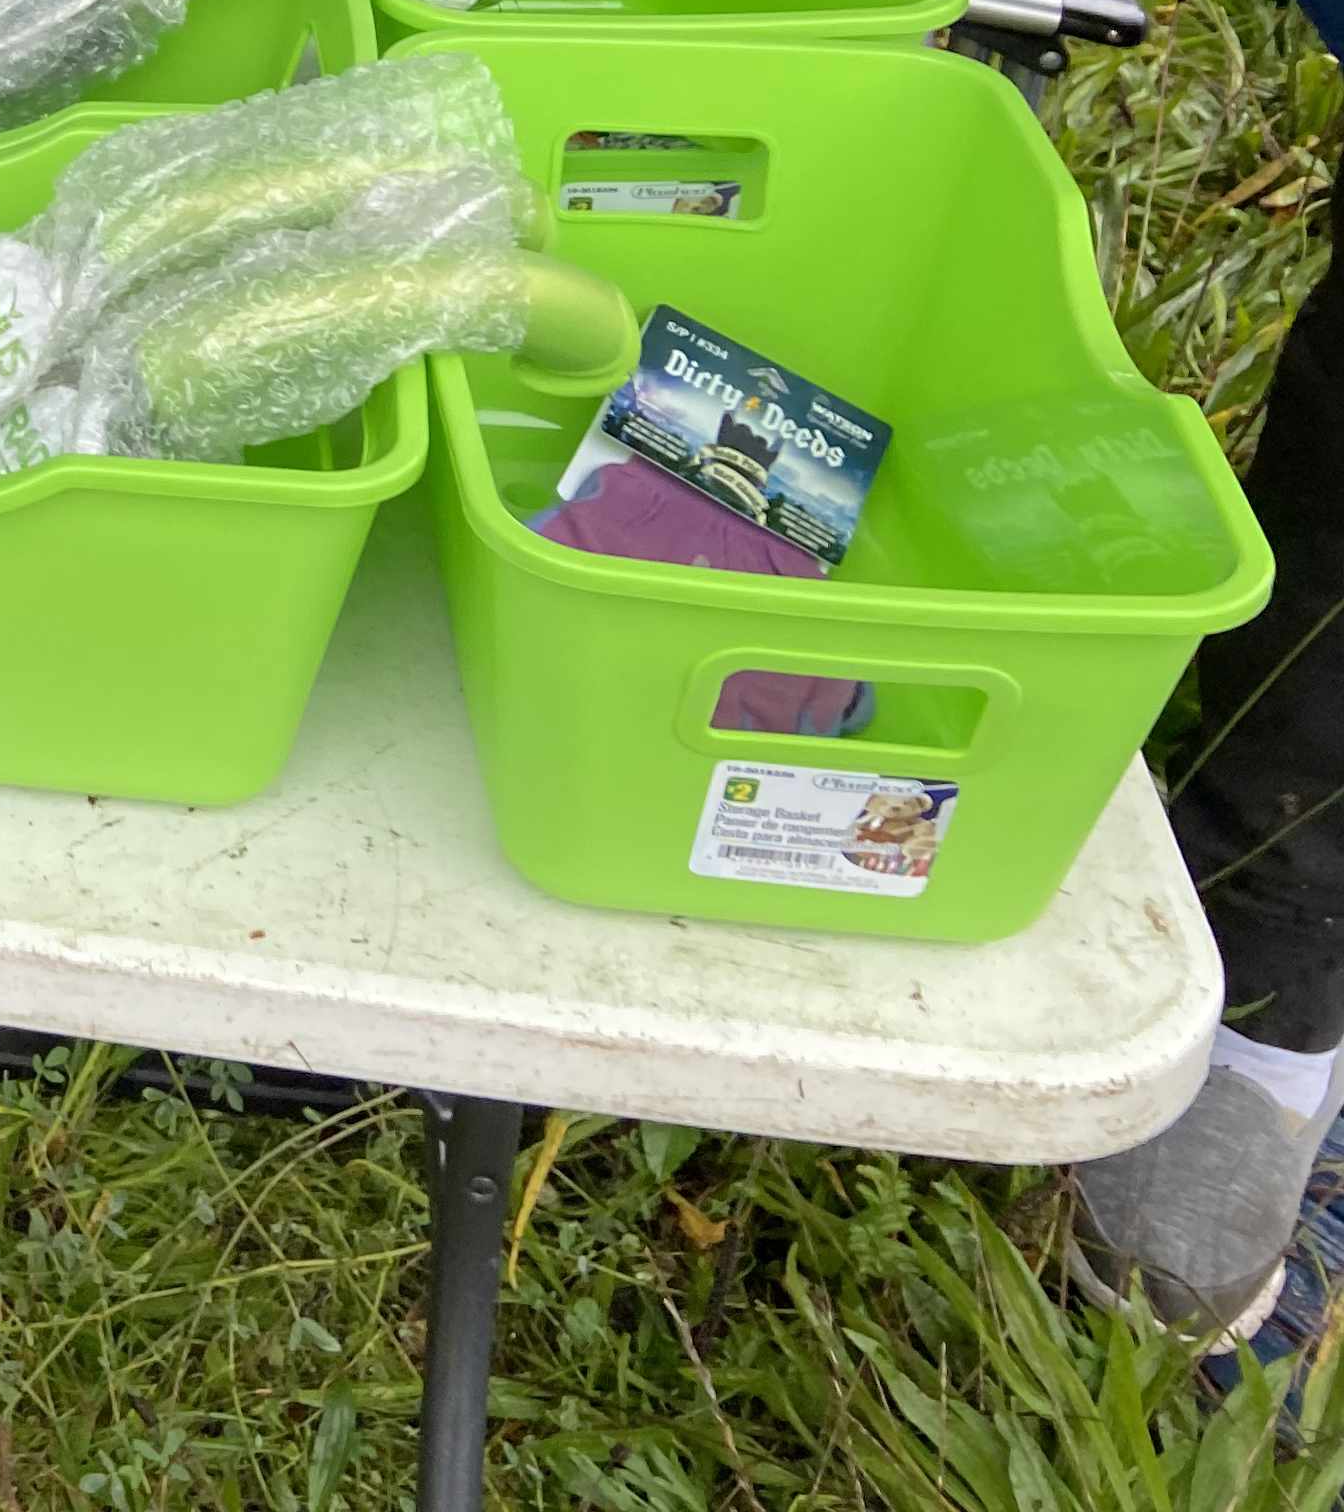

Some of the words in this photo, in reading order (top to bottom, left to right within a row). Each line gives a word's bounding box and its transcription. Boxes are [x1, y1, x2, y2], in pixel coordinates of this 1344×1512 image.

[3, 402, 50, 471] RAD
[664, 349, 744, 411] Dirty
[763, 402, 845, 468] Deeds
